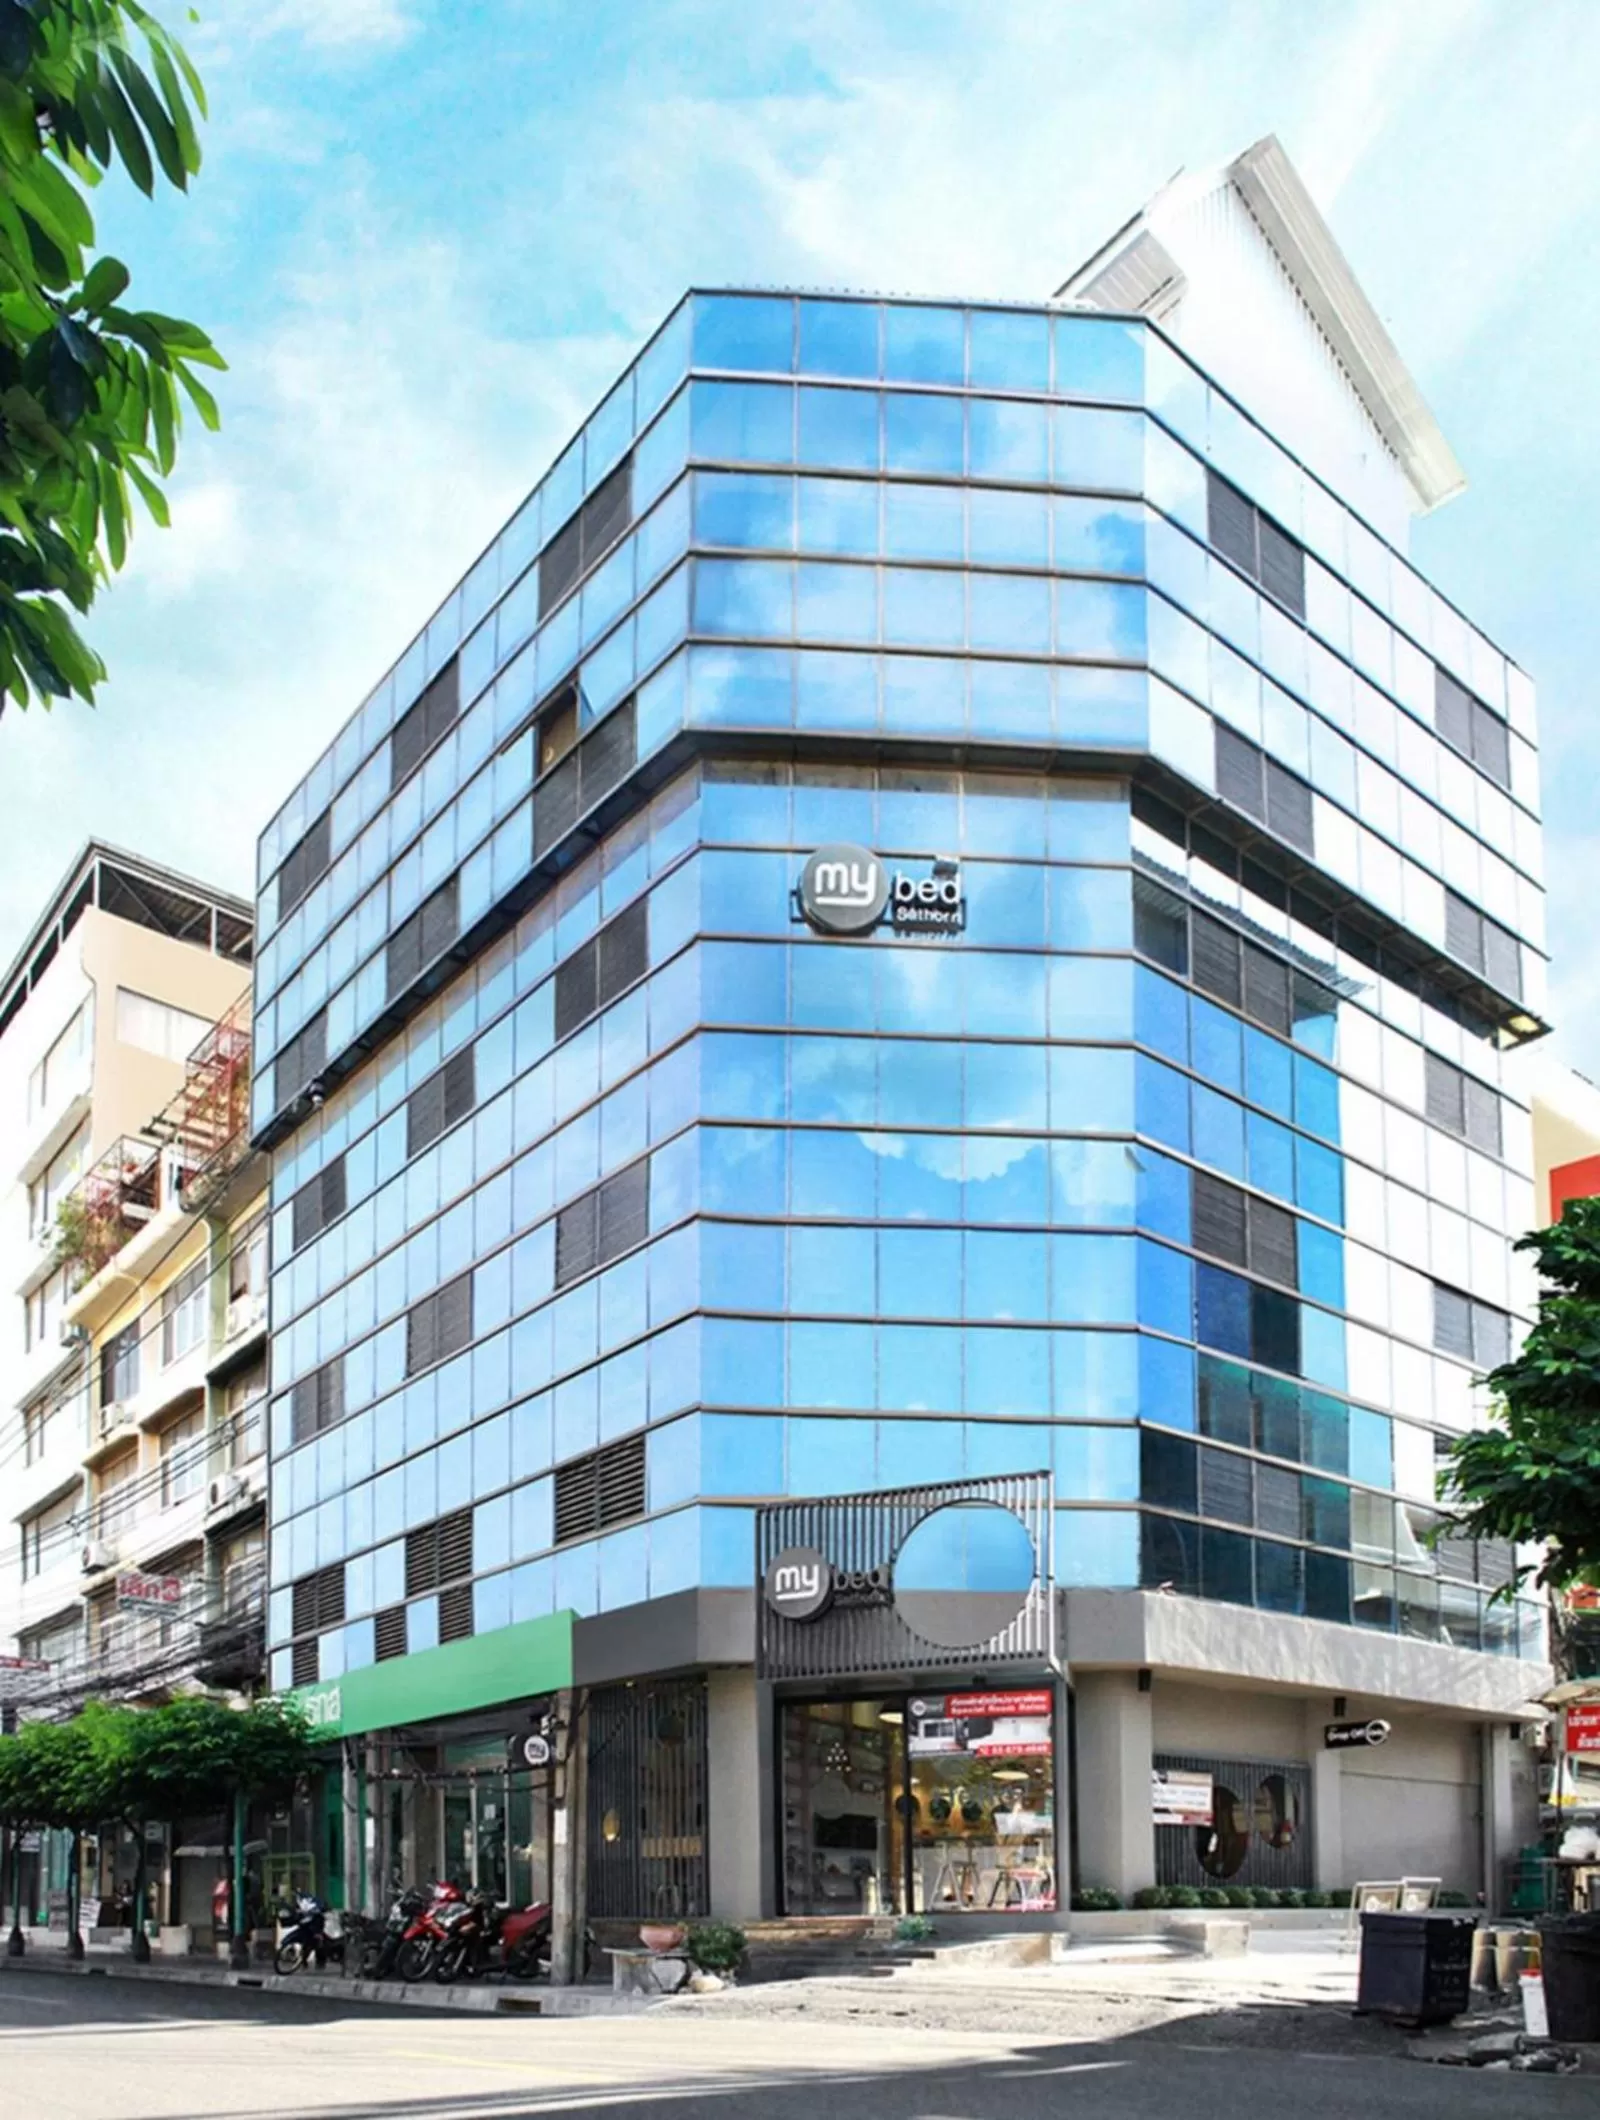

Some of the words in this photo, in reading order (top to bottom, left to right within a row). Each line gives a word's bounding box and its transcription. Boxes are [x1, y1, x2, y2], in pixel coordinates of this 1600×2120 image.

[815, 862, 877, 906] my
[895, 868, 961, 903] bed
[896, 905, 963, 924] Sathorn
[775, 1564, 820, 1600] my
[833, 1563, 889, 1590] bed
